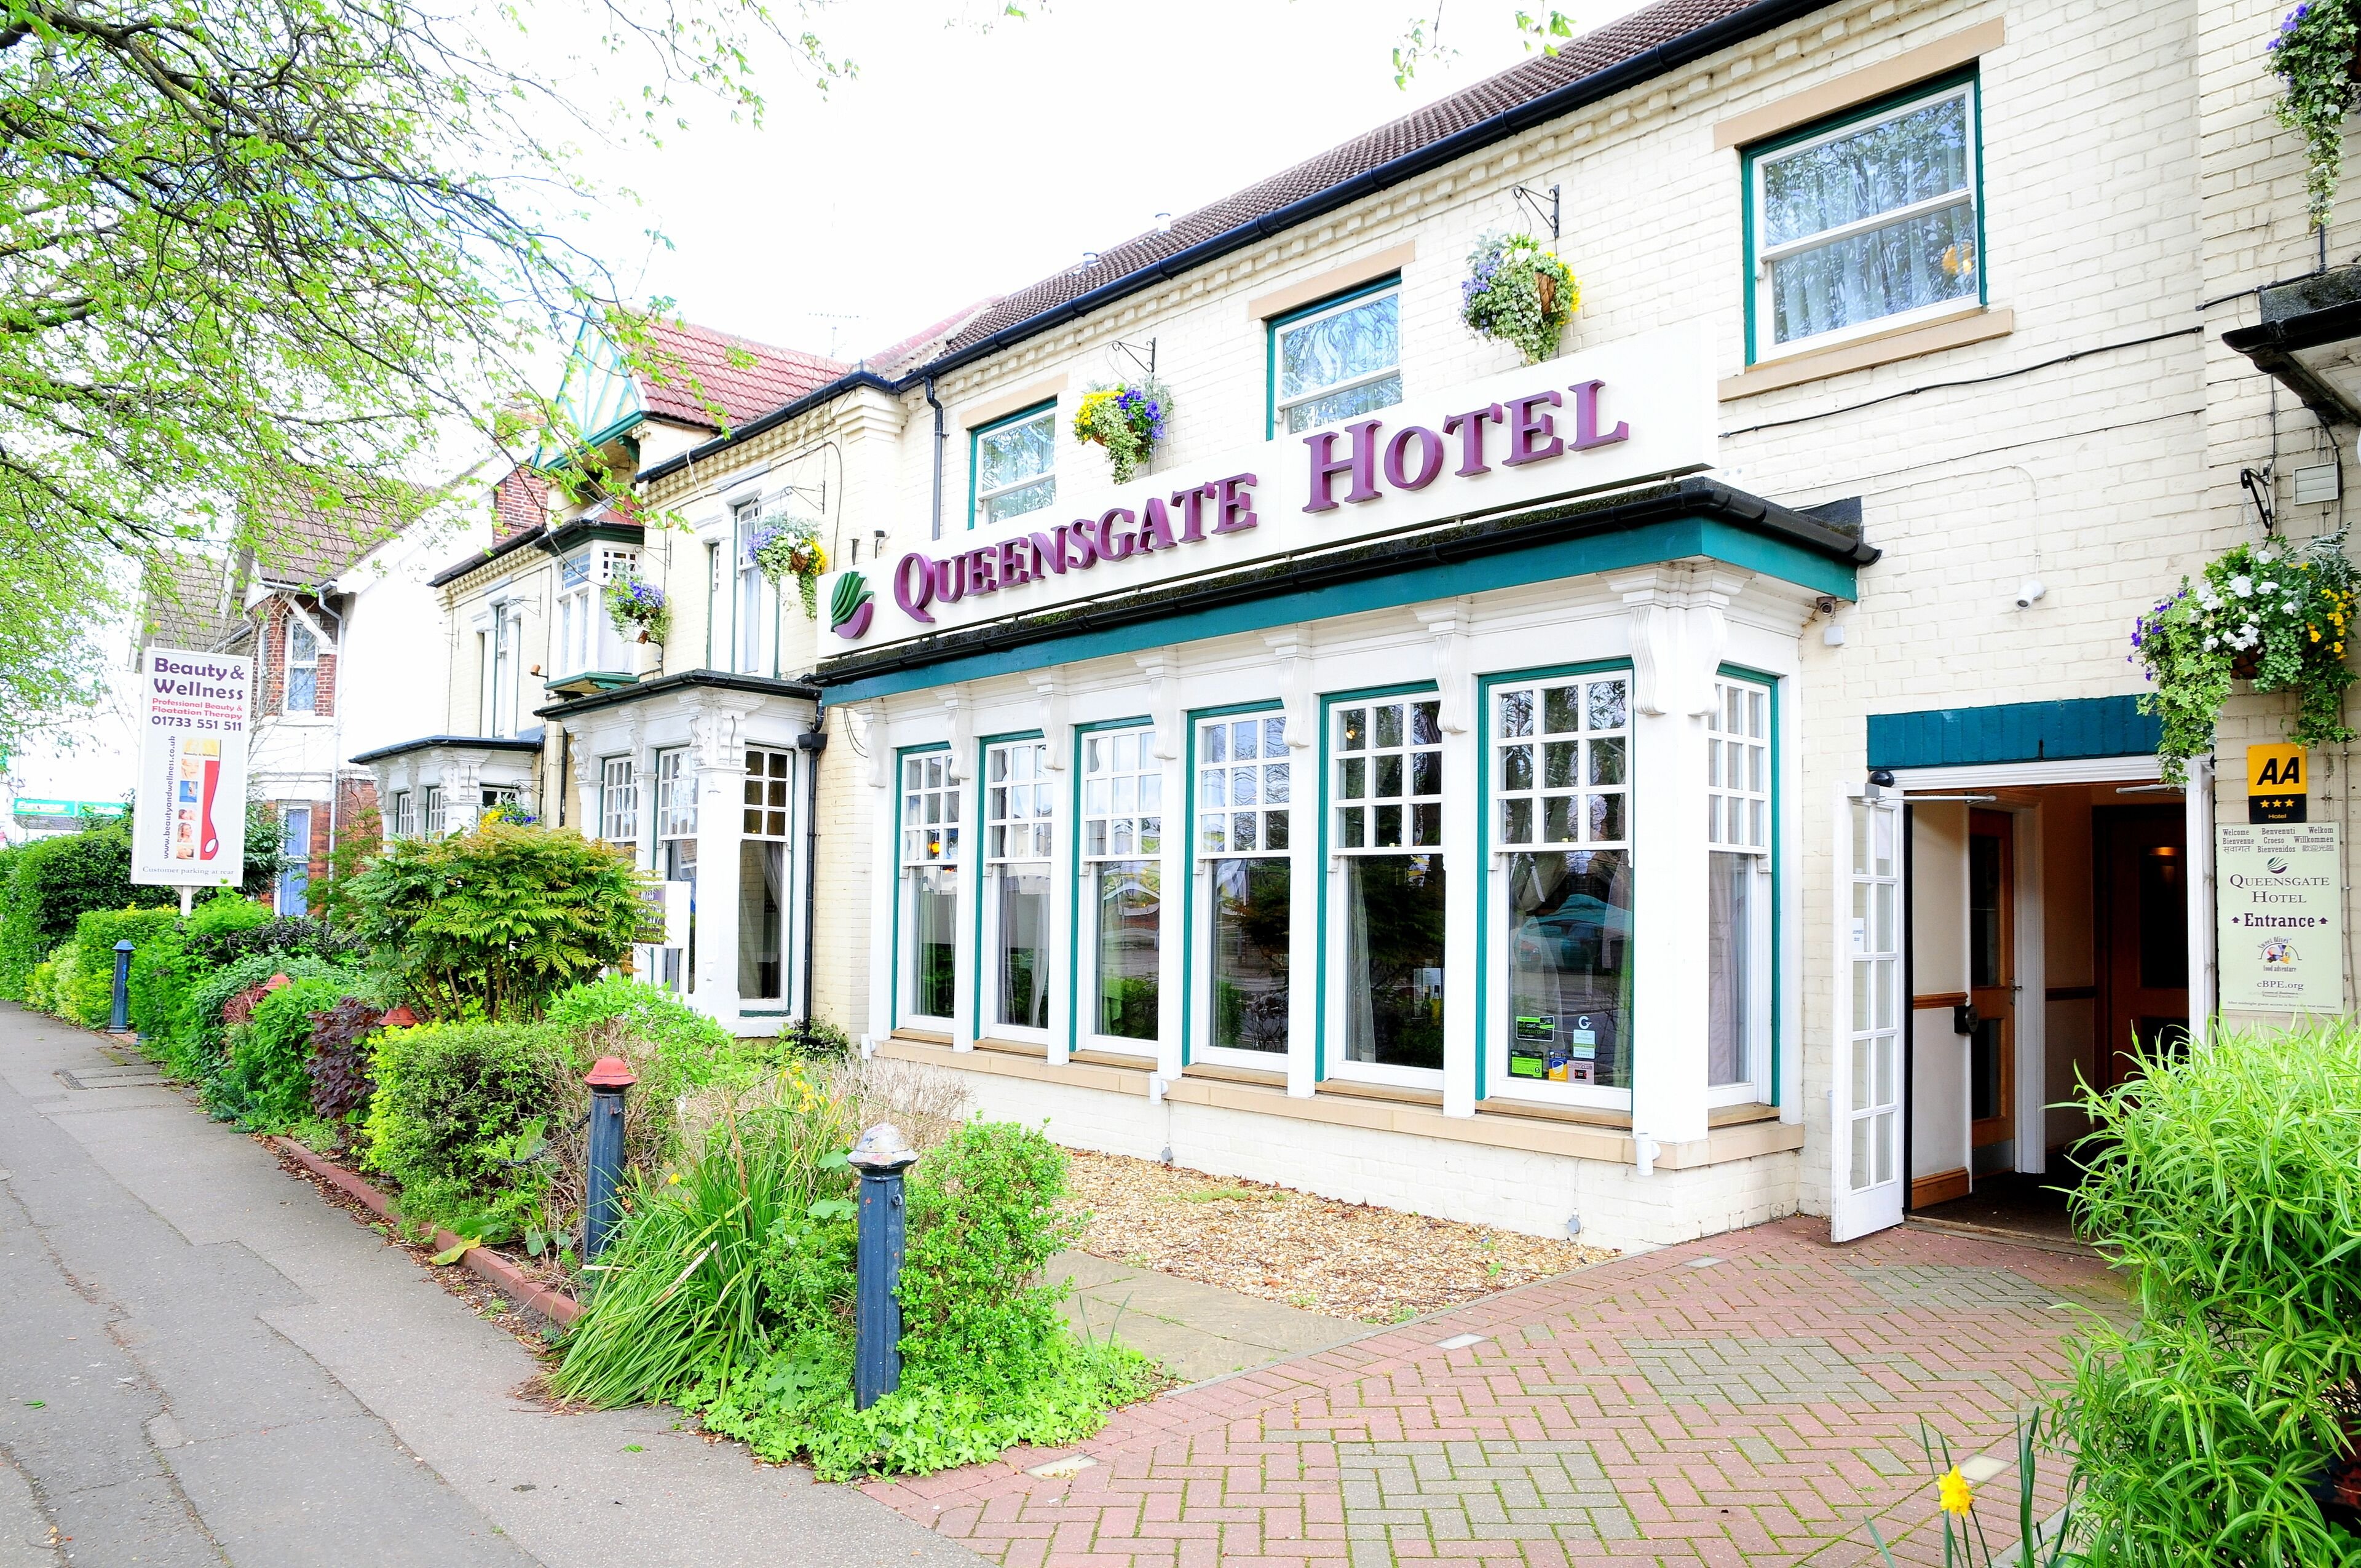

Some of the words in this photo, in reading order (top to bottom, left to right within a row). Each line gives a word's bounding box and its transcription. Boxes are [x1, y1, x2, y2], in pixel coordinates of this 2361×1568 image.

[893, 472, 1257, 623] QUEENSGATE
[1302, 379, 1629, 514] HOTEL
[154, 657, 227, 681] Beauty
[230, 665, 244, 679] &
[154, 678, 243, 700] Wellness
[152, 698, 202, 708] Professional
[205, 702, 234, 711] Beauty
[152, 706, 202, 715] Floatation
[204, 710, 242, 720] Therapy
[151, 716, 191, 727] 01733
[197, 719, 218, 729] 551
[224, 721, 242, 731] 511
[2256, 757, 2300, 785] AA
[2230, 874, 2330, 889] QUEENSGATE
[2252, 891, 2307, 903] HOTEL
[2244, 913, 2315, 927] Entrance
[2256, 980, 2304, 991] cBPE.org
